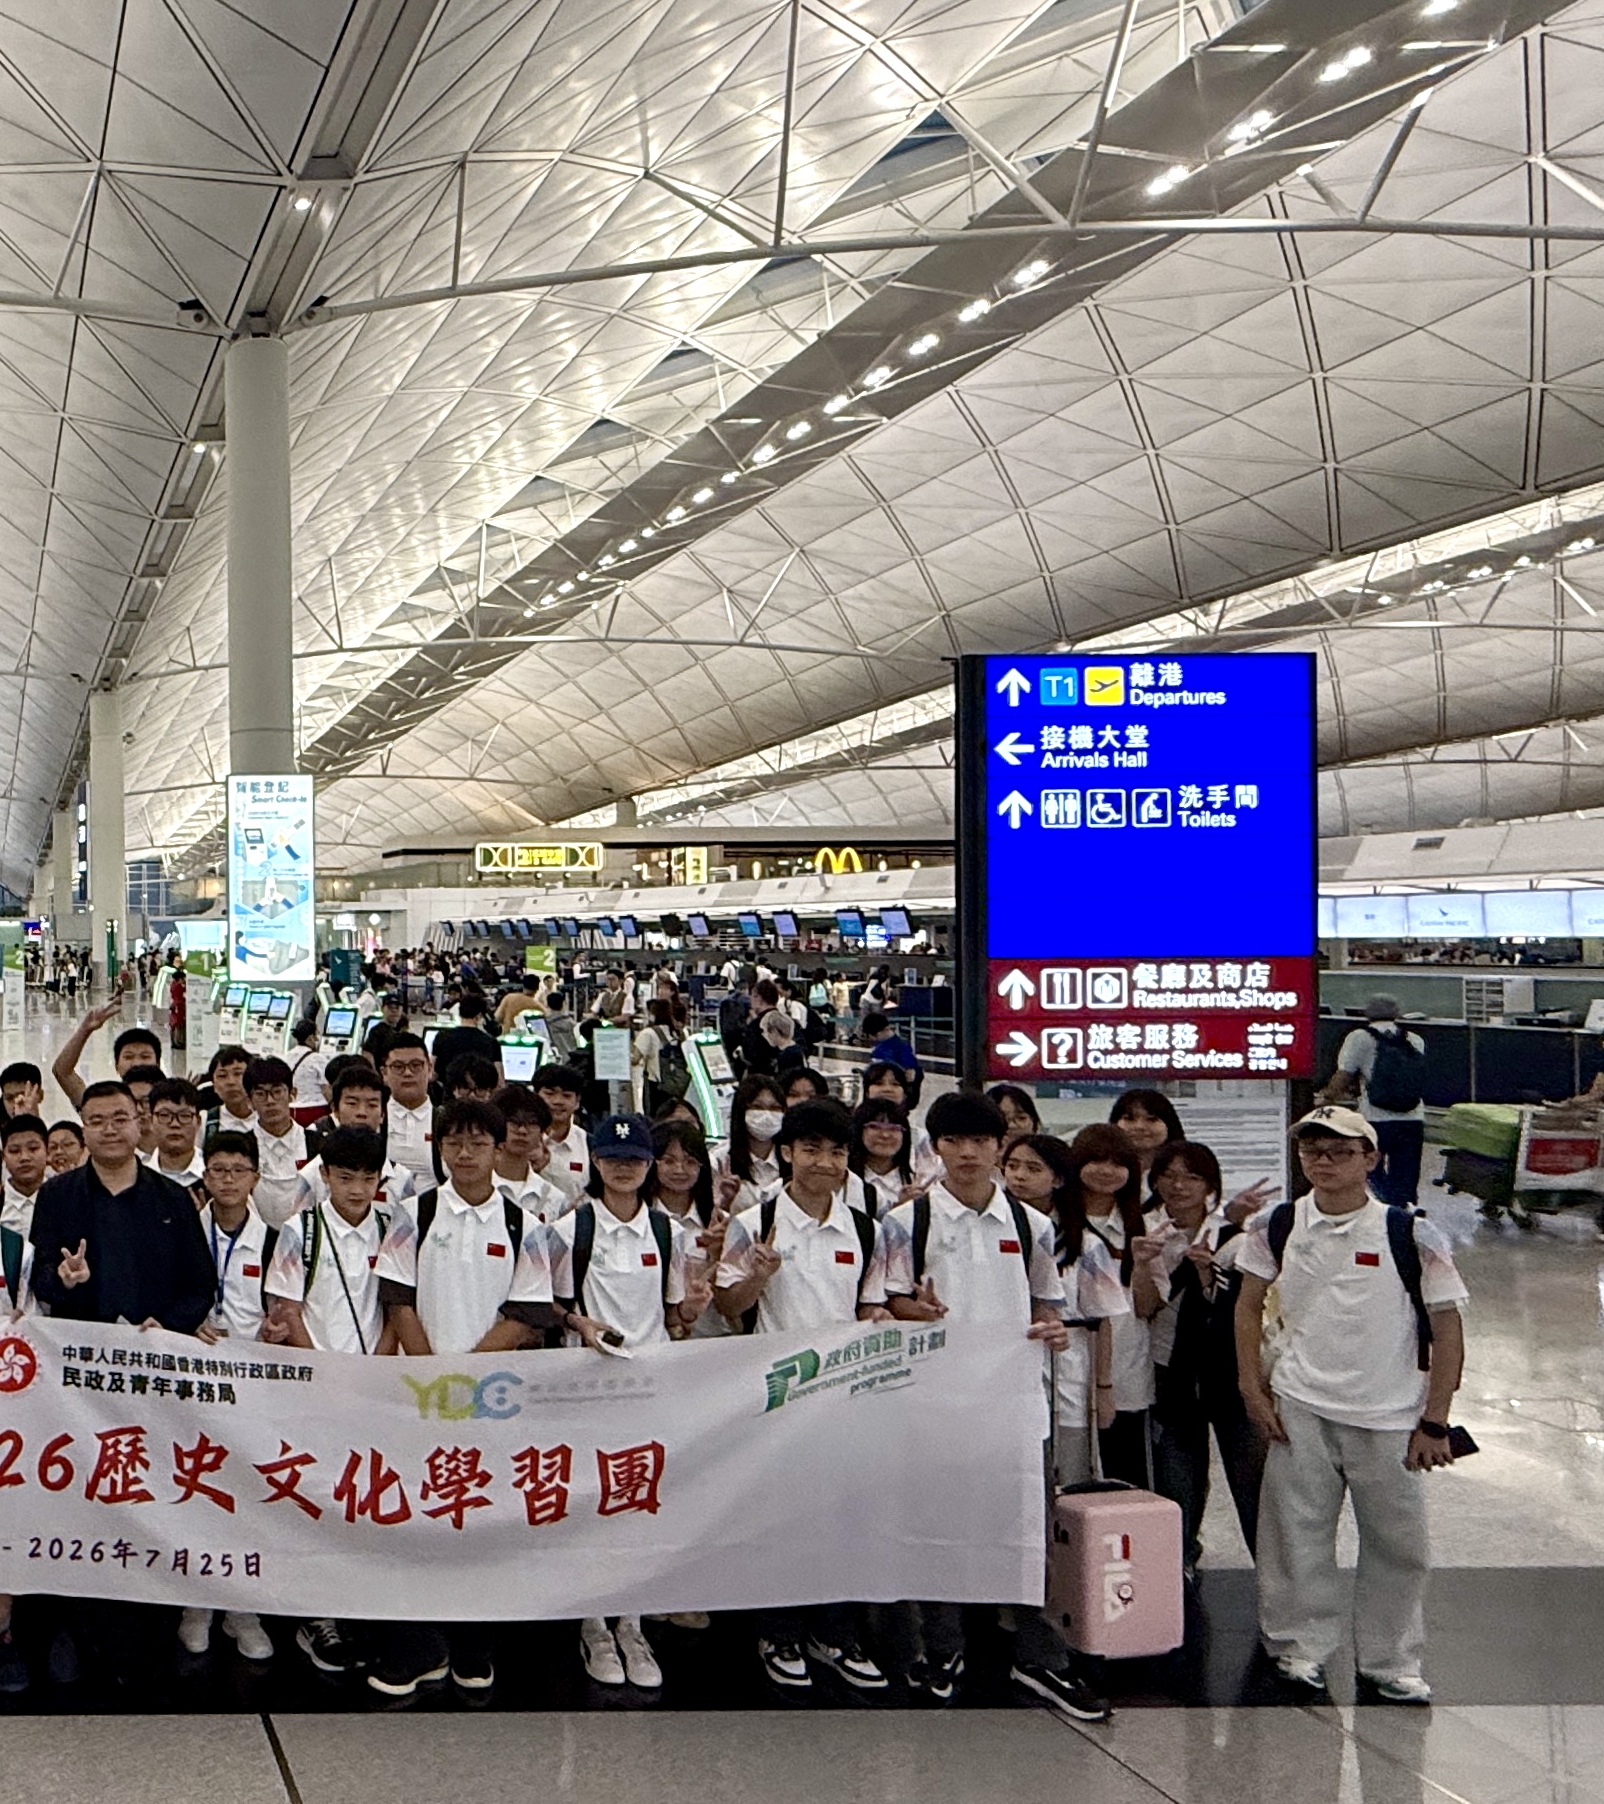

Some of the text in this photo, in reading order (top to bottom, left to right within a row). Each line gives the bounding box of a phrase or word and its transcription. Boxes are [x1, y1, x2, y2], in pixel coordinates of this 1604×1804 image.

[1045, 675, 1074, 698] T1
[1129, 662, 1183, 687] 離港
[1129, 689, 1227, 708] Departures
[1040, 725, 1149, 750] 接機大堂
[1040, 752, 1148, 768] Arrivals Hall
[1178, 785, 1259, 809] 洗手間
[1177, 811, 1237, 827] Toilets
[543, 949, 556, 967] 2
[1132, 962, 1271, 989] 餐廳及商店
[1087, 1024, 1199, 1050] 旅客服務
[1087, 1051, 1169, 1069] Customer
[1172, 1050, 1244, 1069] Services
[62, 1344, 314, 1382] 中華人民共和國香港特別行政區政府
[62, 1366, 236, 1405] 民政及青年事務局
[850, 1367, 912, 1395] programme
[28, 1536, 262, 1578] 2026年7月25日
